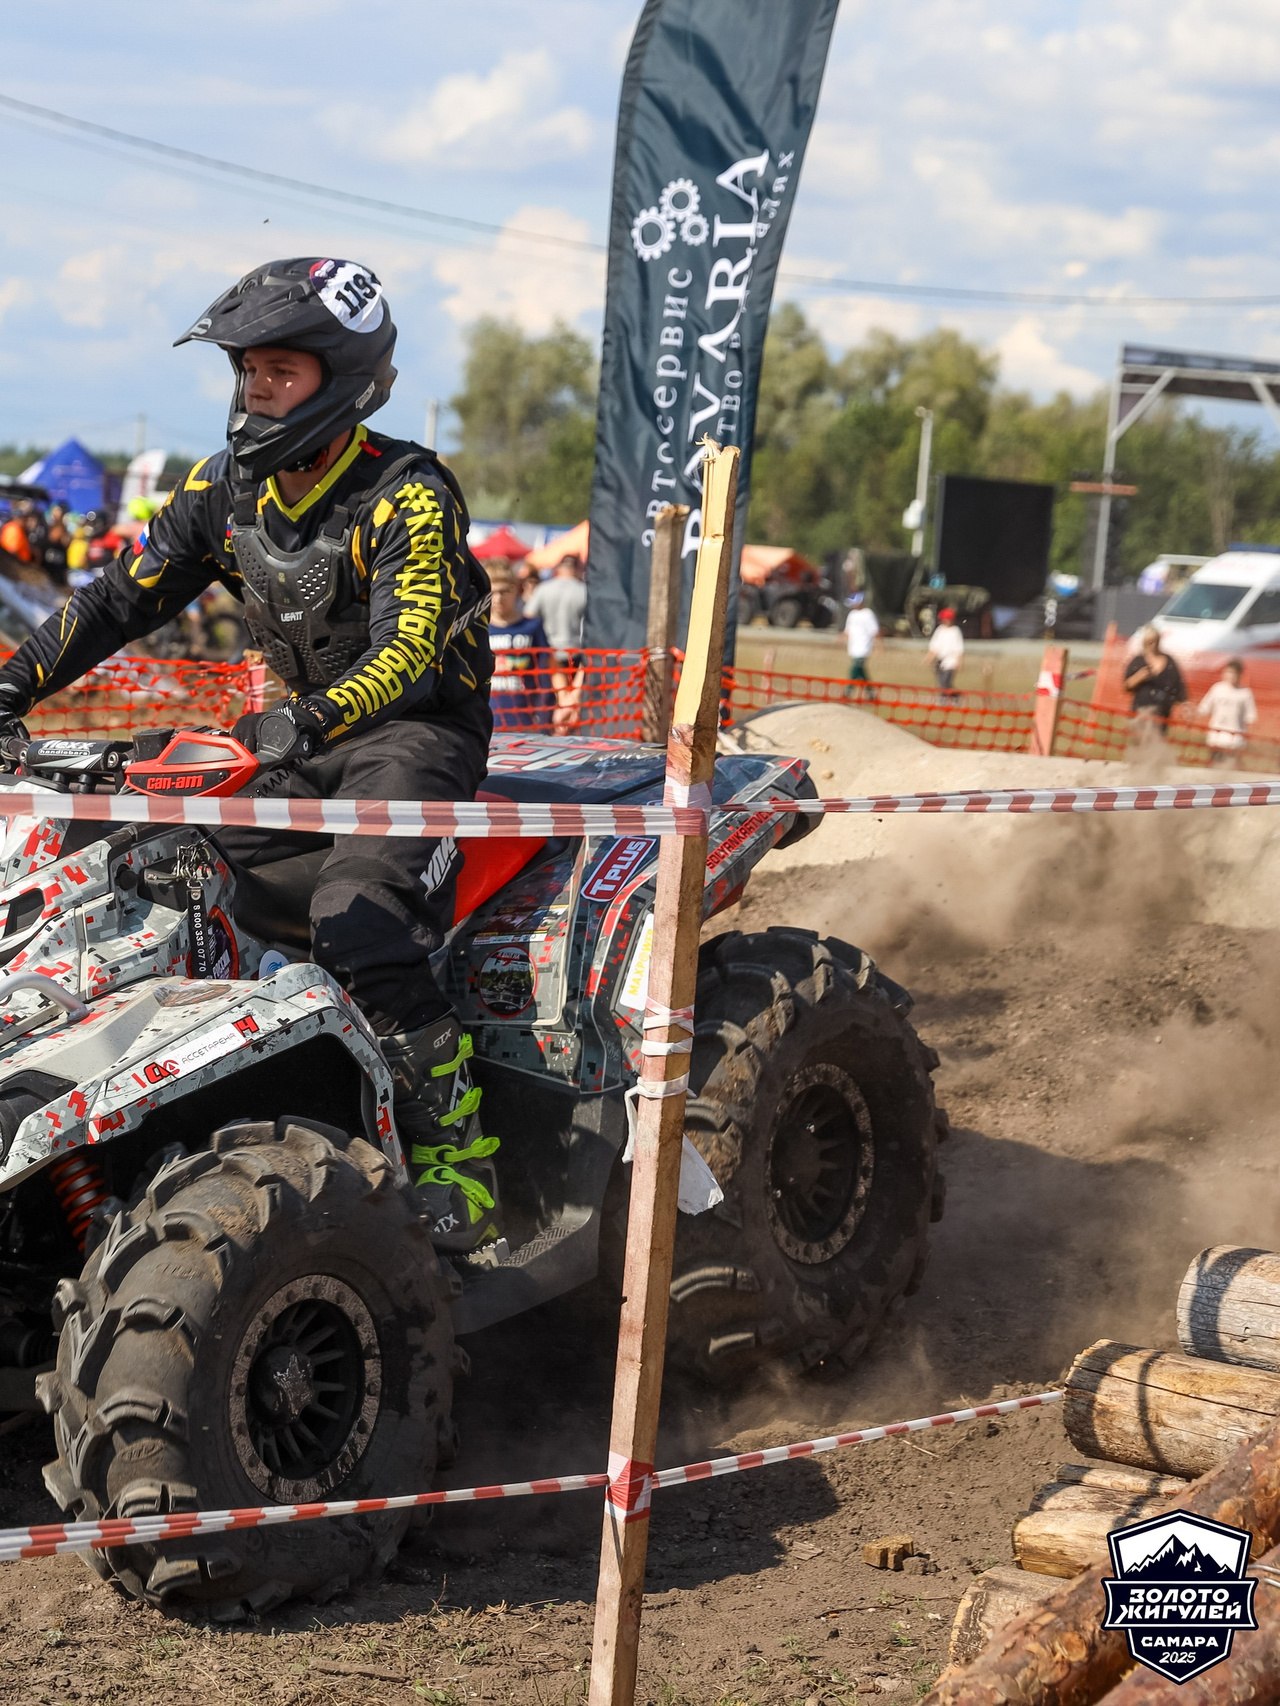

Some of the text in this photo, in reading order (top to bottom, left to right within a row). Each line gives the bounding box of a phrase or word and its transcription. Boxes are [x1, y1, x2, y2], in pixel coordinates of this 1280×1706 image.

[335, 273, 378, 319] 119
[280, 610, 304, 622] LEATT
[42, 740, 96, 750] flexx
[146, 774, 204, 791] can-am
[193, 912, 202, 929] 800
[195, 930, 204, 947] 333
[197, 948, 207, 959] 07
[198, 961, 207, 972] 70
[433, 1028, 452, 1049] GTX
